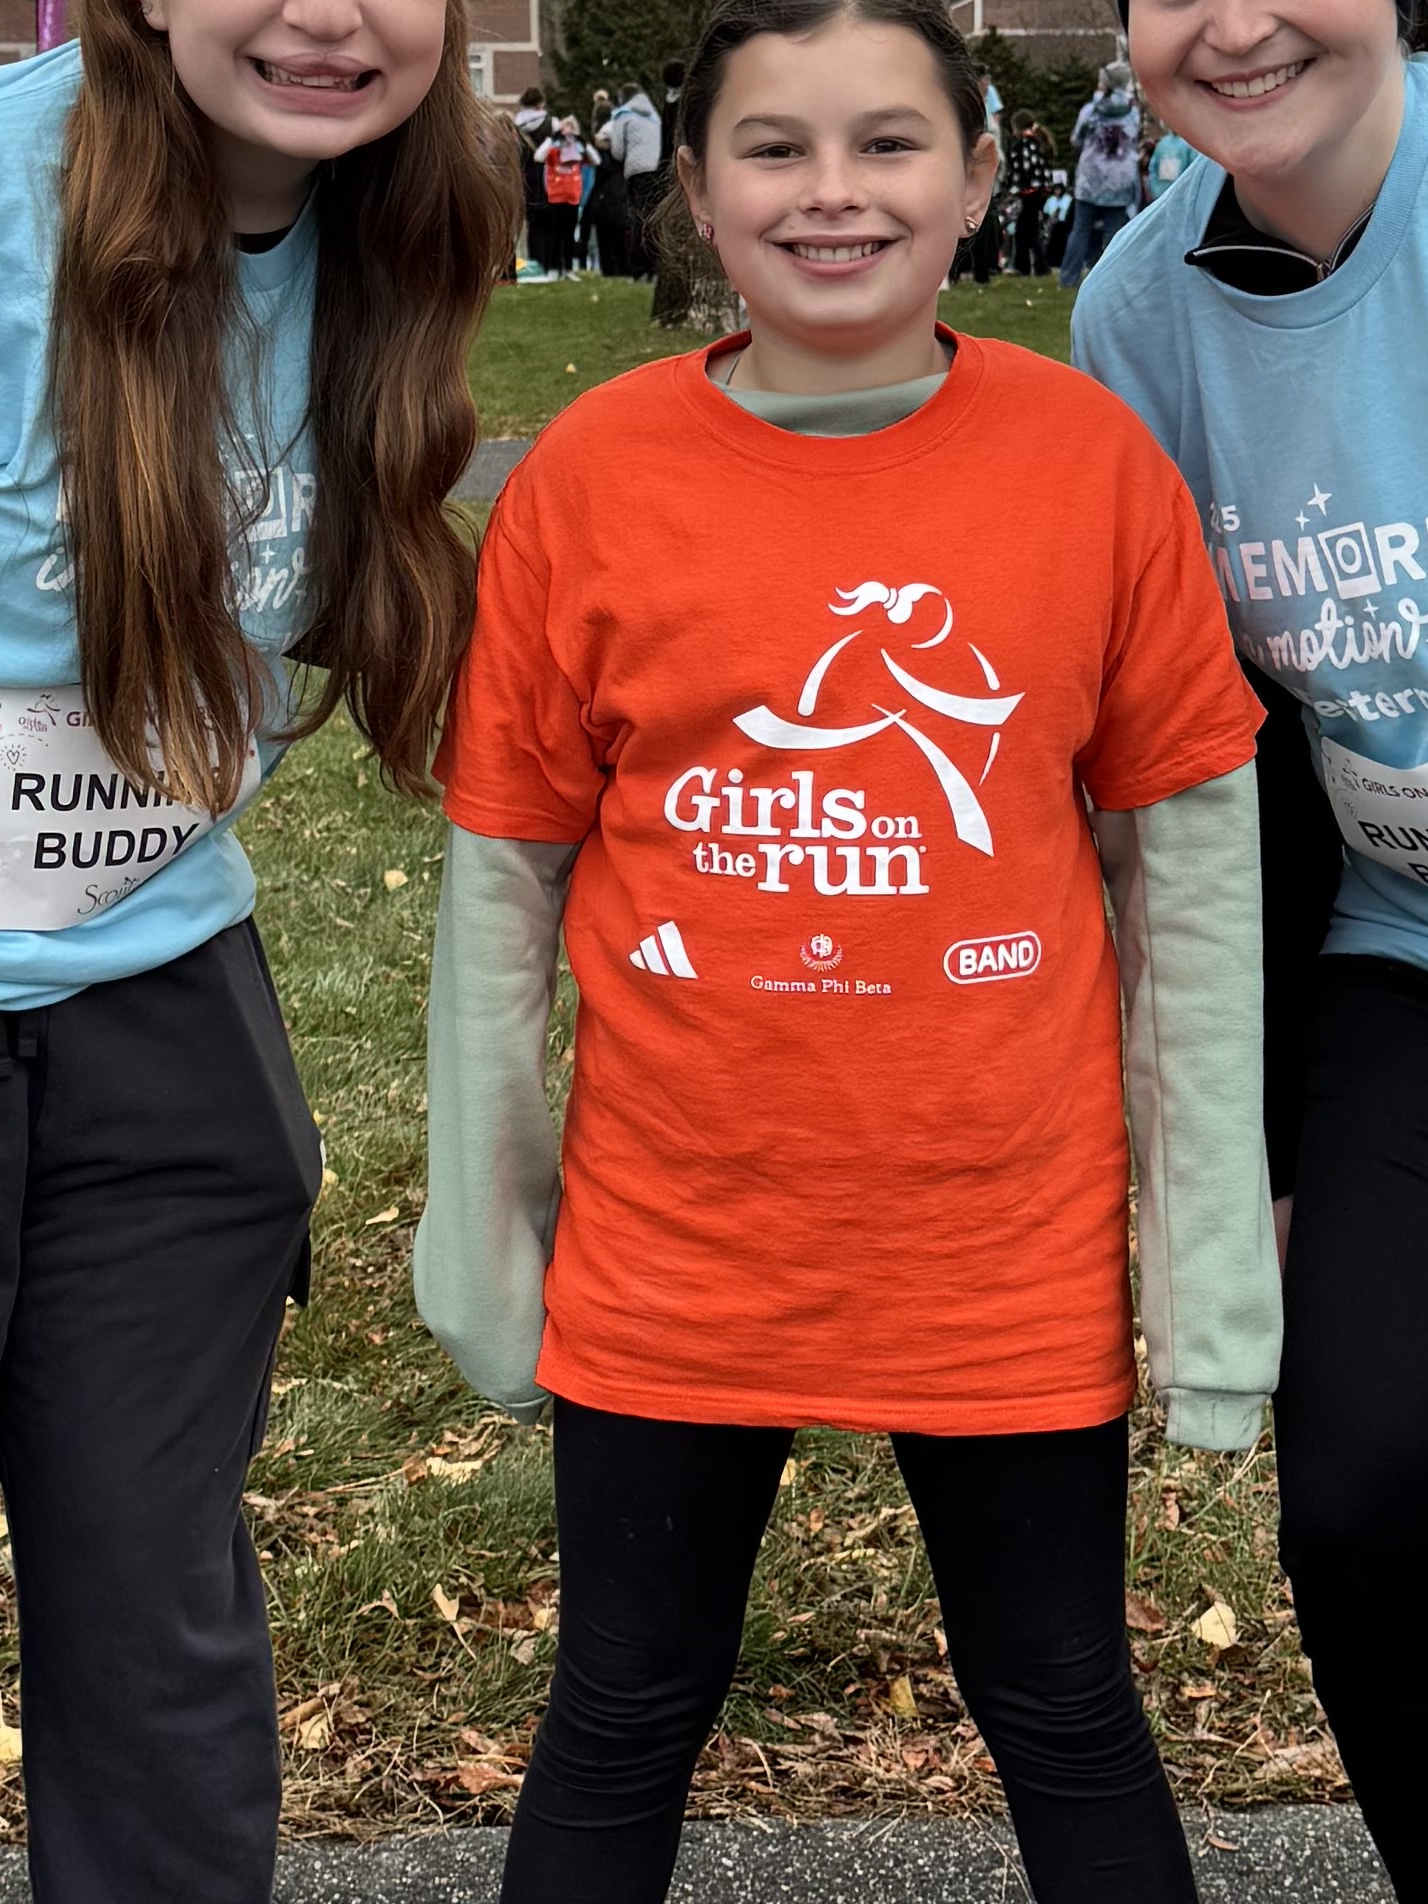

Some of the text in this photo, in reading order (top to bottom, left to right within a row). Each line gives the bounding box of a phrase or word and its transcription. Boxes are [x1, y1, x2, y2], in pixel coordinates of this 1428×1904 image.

[11, 771, 177, 812] RUNNI
[664, 765, 923, 840] Girls on
[1362, 777, 1401, 798] GIRLS
[33, 823, 200, 869] BUDDY
[693, 841, 930, 896] the run
[959, 940, 1034, 976] BAND
[750, 975, 892, 996] Gamma Phi Beta
